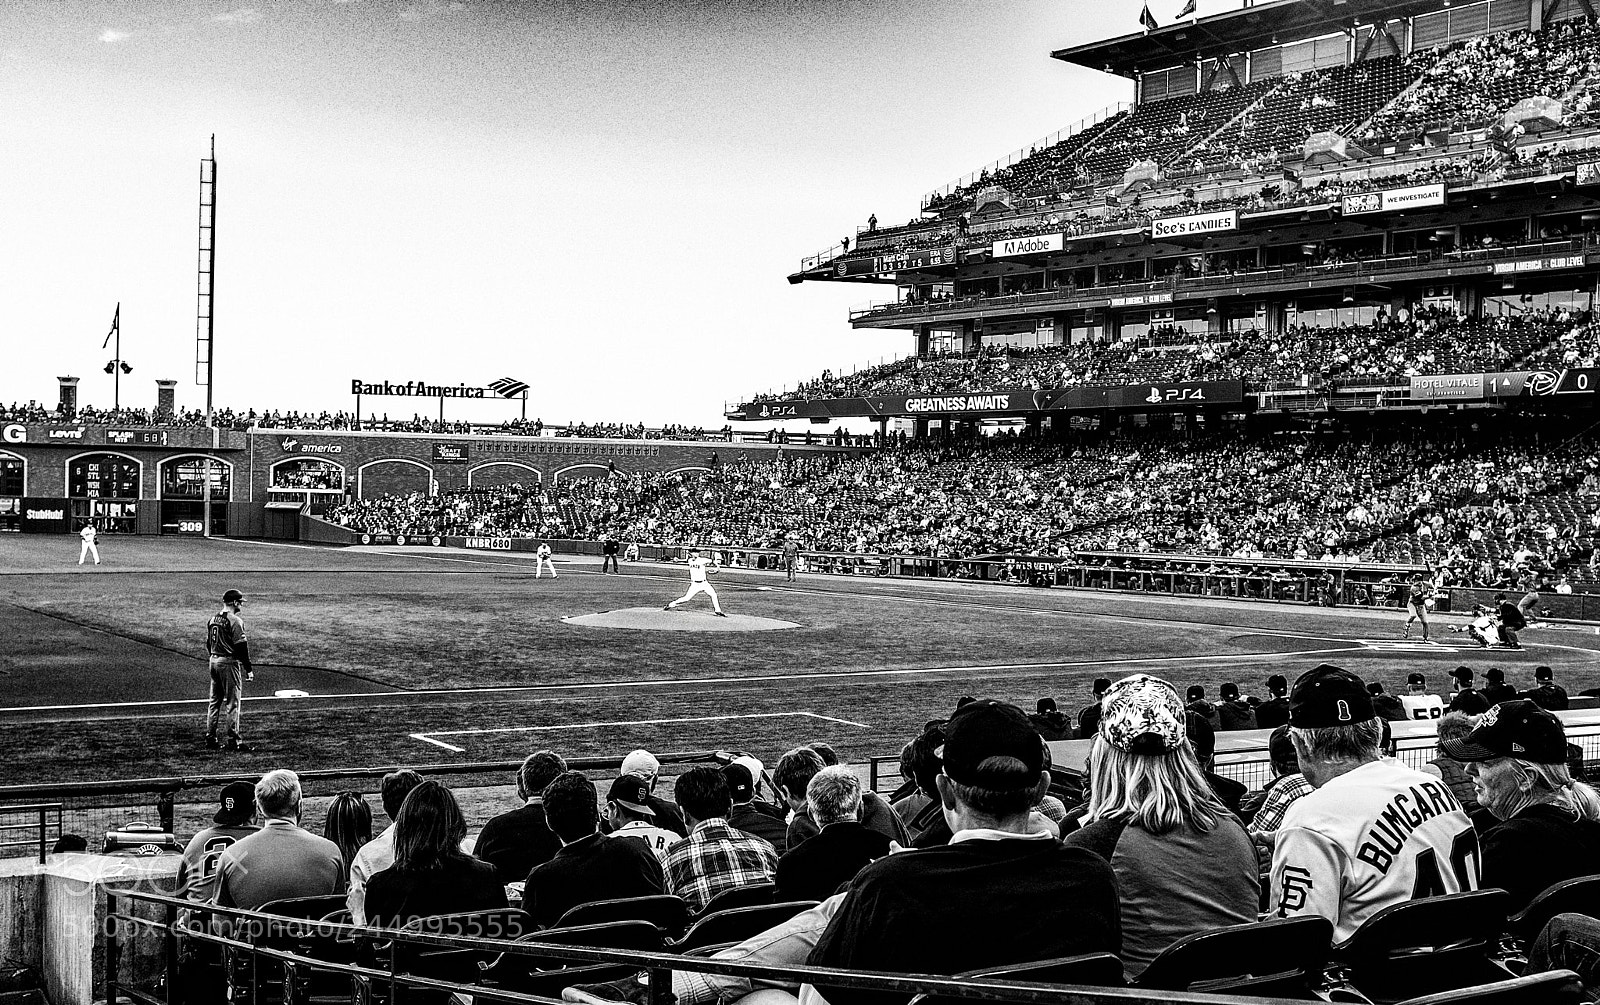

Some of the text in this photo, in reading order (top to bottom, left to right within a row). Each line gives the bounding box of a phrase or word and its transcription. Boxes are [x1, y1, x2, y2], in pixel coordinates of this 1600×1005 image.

[1398, 191, 1440, 202] INVESTIGATE
[1155, 217, 1231, 235] See's CANDIES
[1017, 238, 1050, 253] Adobe
[1549, 258, 1565, 268] CLUB
[1566, 256, 1584, 267] LEVEL
[1414, 377, 1479, 389] HOTEL VITALE
[1490, 377, 1497, 393] 1
[1577, 374, 1588, 389] 0
[351, 379, 485, 399] Bank of America
[1166, 388, 1206, 401] PS4
[905, 395, 1009, 412] GREATNESS AWAITS
[771, 406, 797, 415] PS4
[301, 443, 342, 453] america
[88, 463, 100, 471] CHI
[87, 471, 100, 480] STL
[26, 509, 64, 520] StubHub!
[179, 521, 203, 532] 309
[465, 537, 510, 548] KNBR 680
